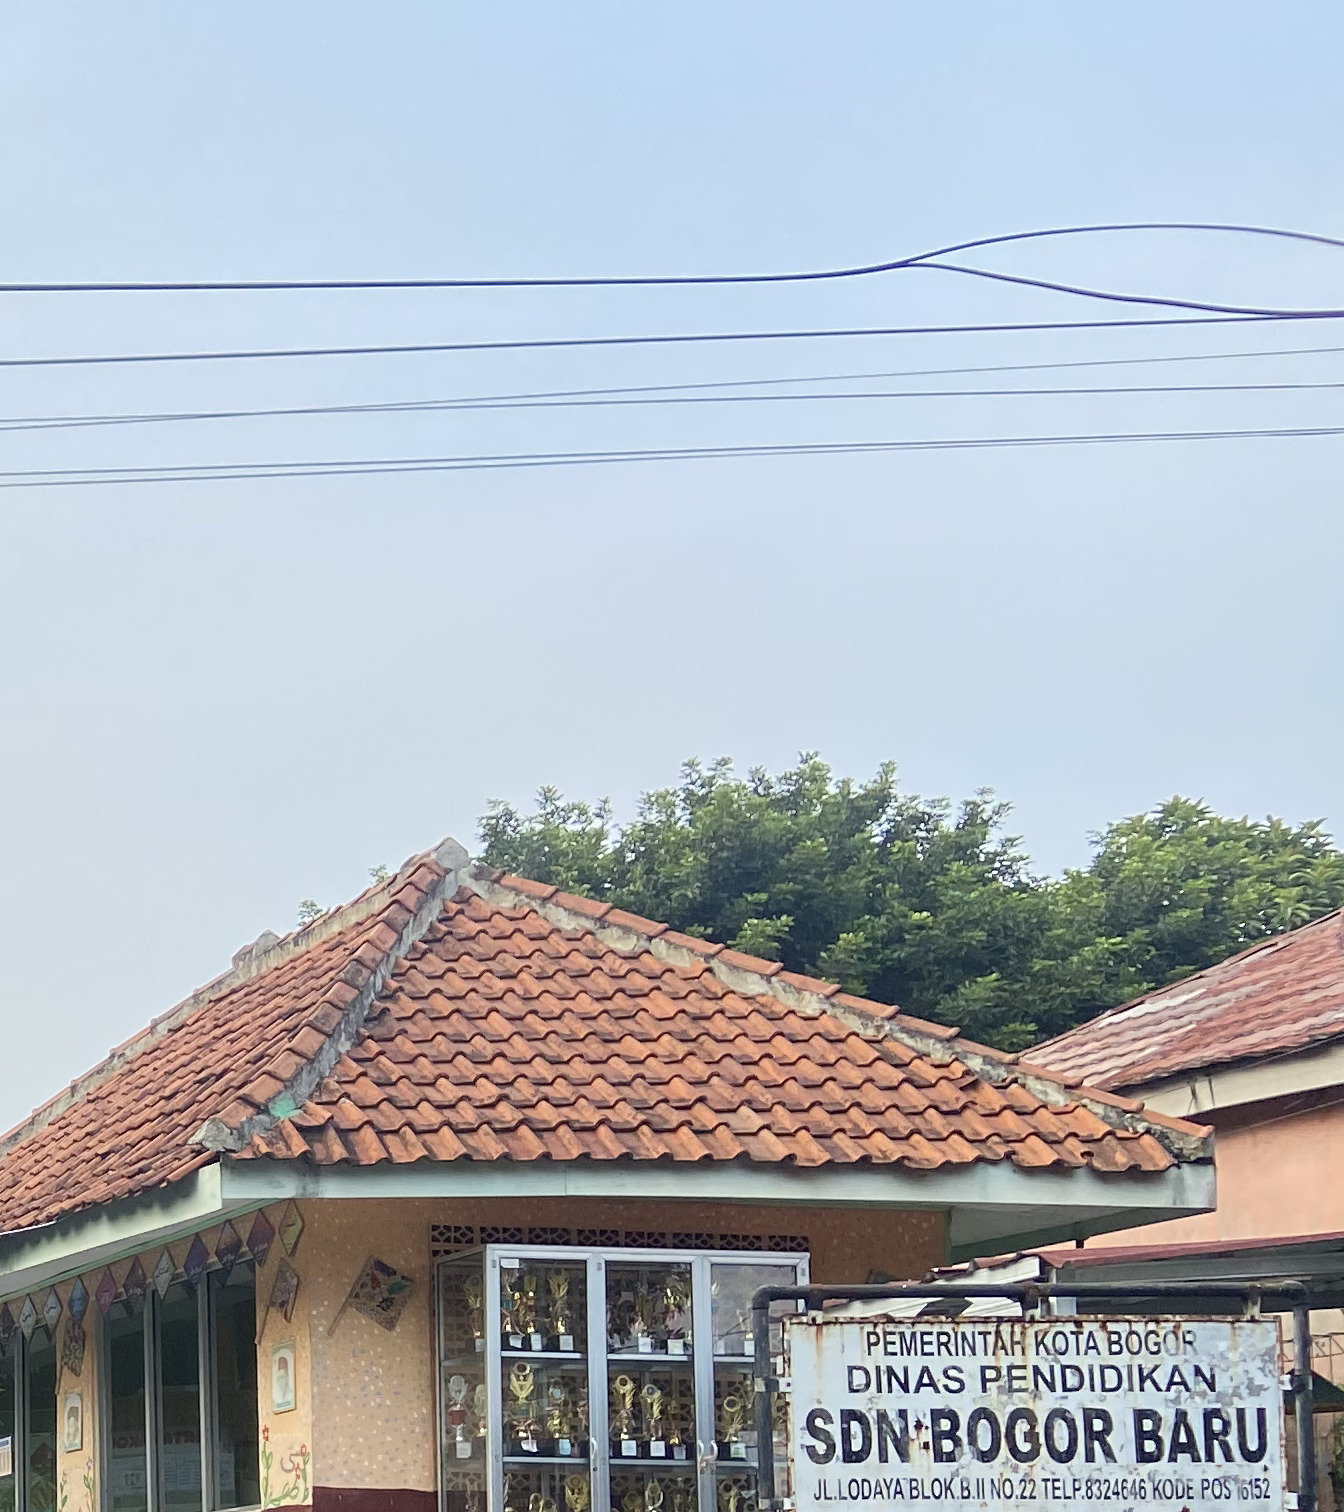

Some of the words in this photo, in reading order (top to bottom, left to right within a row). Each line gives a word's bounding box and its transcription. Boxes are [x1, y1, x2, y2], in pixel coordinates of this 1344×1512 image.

[866, 1330, 1026, 1357] PEMERINTAH
[1034, 1329, 1101, 1356] KOTA
[1107, 1329, 1198, 1357] BOGOR
[847, 1364, 965, 1394] DINAS
[980, 1363, 1217, 1394] PENDIDIKAN
[805, 1407, 911, 1464] SDN
[930, 1406, 1118, 1464] BOGOR
[1133, 1407, 1268, 1464] BARU
[990, 1477, 1037, 1500] NO.22
[1152, 1478, 1195, 1500] KODE
[1201, 1478, 1232, 1500] POS
